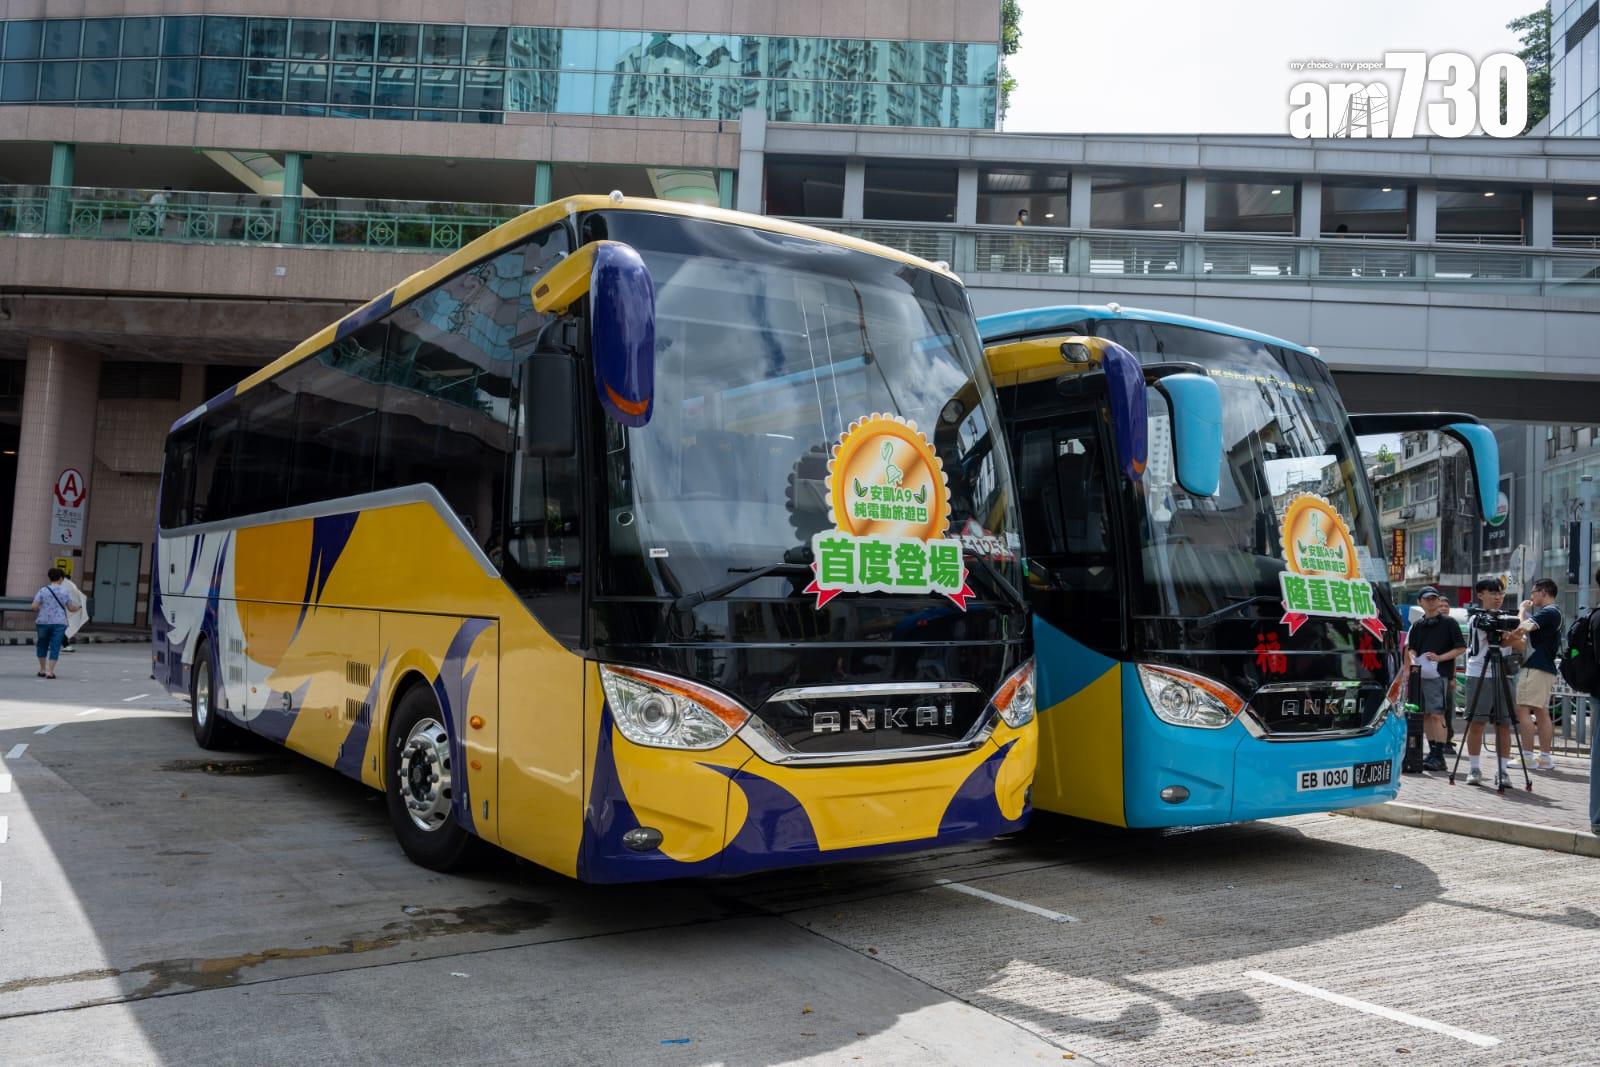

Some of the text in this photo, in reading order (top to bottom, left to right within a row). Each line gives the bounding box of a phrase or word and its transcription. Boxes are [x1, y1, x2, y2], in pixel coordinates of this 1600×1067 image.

[62, 473, 78, 497] A
[854, 501, 928, 522] 純電動旅遊巴
[818, 537, 961, 588] 首度登場
[1281, 697, 1365, 716] ANKAI
[812, 705, 953, 733] ANKAI
[1301, 769, 1348, 789] EB 1030
